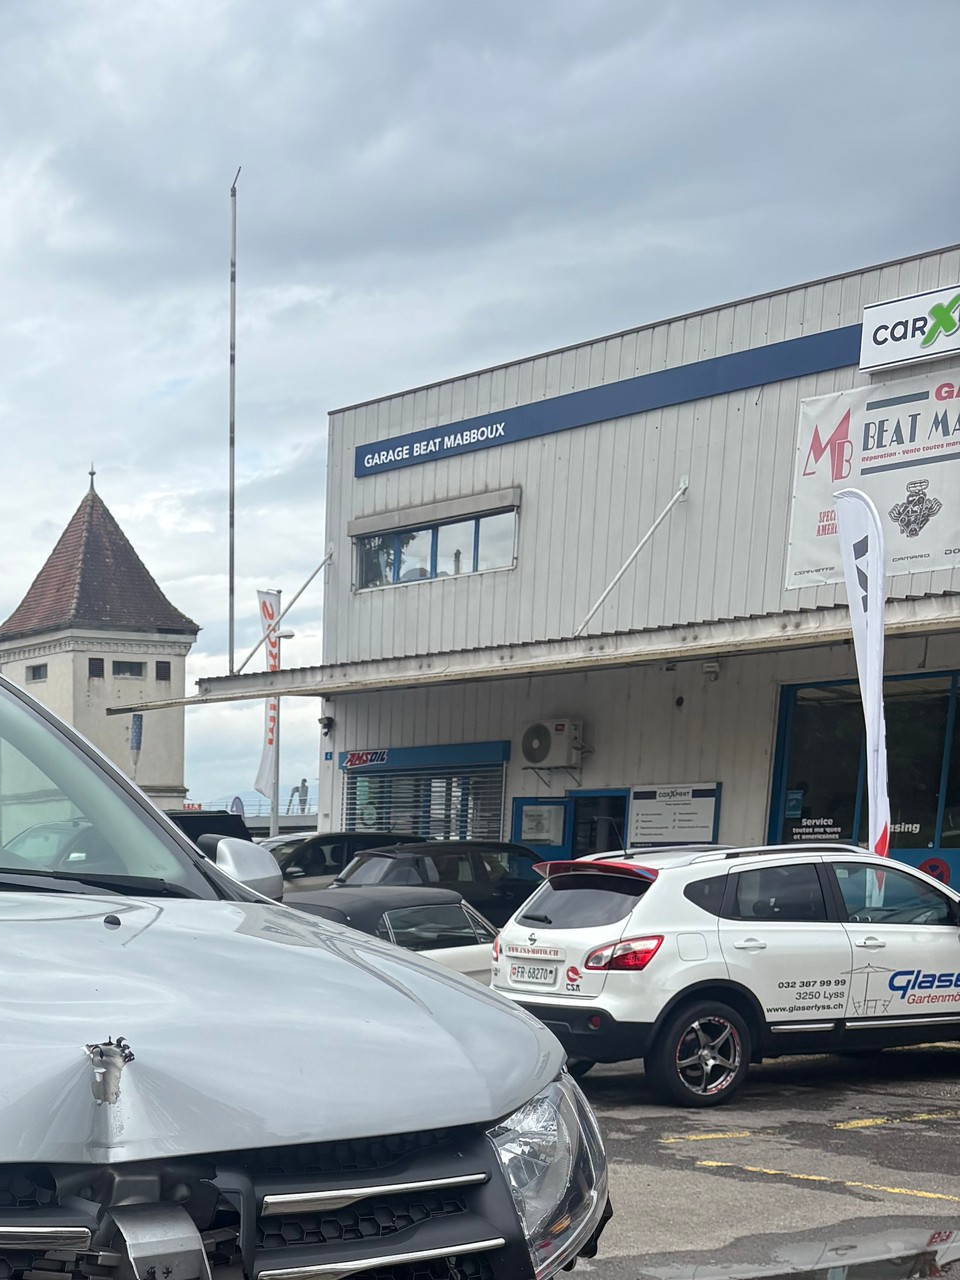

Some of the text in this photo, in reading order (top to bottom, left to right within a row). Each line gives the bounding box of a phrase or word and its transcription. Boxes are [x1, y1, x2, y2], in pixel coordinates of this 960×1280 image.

[862, 413, 921, 451] BEAT
[364, 422, 506, 467] GARAGE BEAT MABBOUX
[902, 447, 921, 456] Vente
[922, 443, 945, 452] toutes
[892, 553, 930, 562] CAMARO
[944, 548, 960, 556] DO
[343, 750, 388, 768] AMSOIL
[801, 817, 834, 826] Service
[778, 979, 847, 989] 032 387 99 99
[795, 990, 845, 1000] 3250 Lyss
[907, 992, 960, 1005] Gartenmö
[766, 1003, 844, 1014] www.glaserlyss.ch
